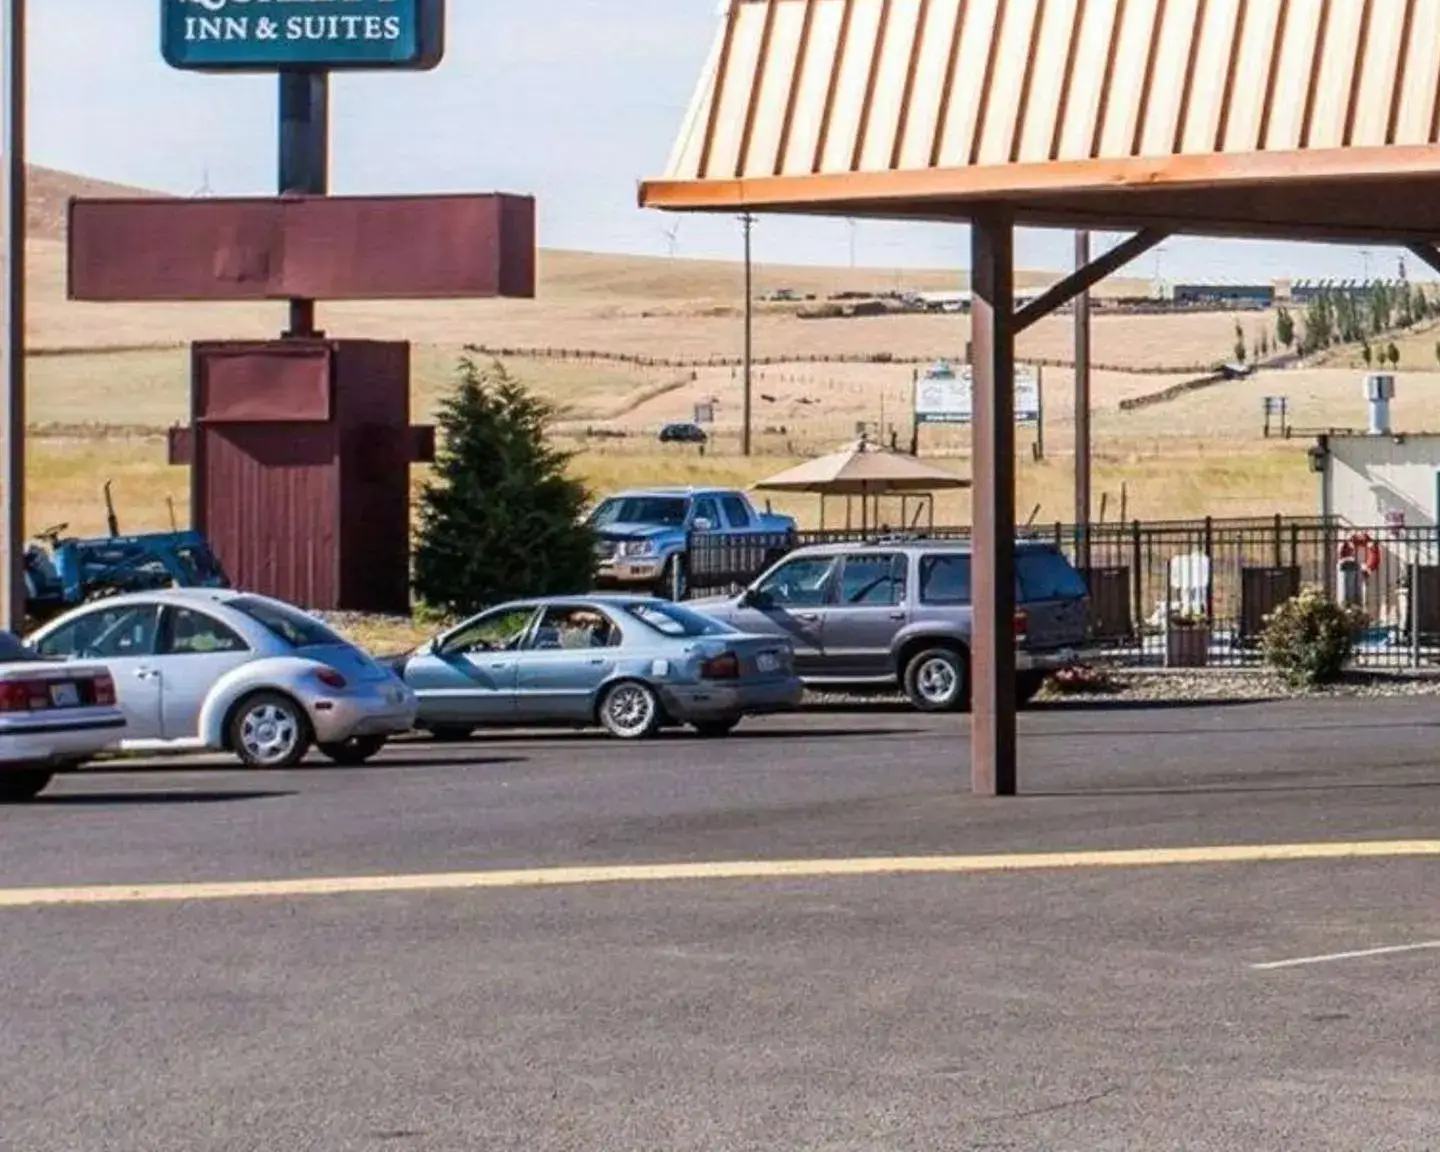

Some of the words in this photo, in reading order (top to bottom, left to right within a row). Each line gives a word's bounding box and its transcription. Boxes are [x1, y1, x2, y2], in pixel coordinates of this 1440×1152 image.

[184, 17, 247, 40] INN
[255, 16, 278, 40] &
[286, 16, 400, 40] SUITES
